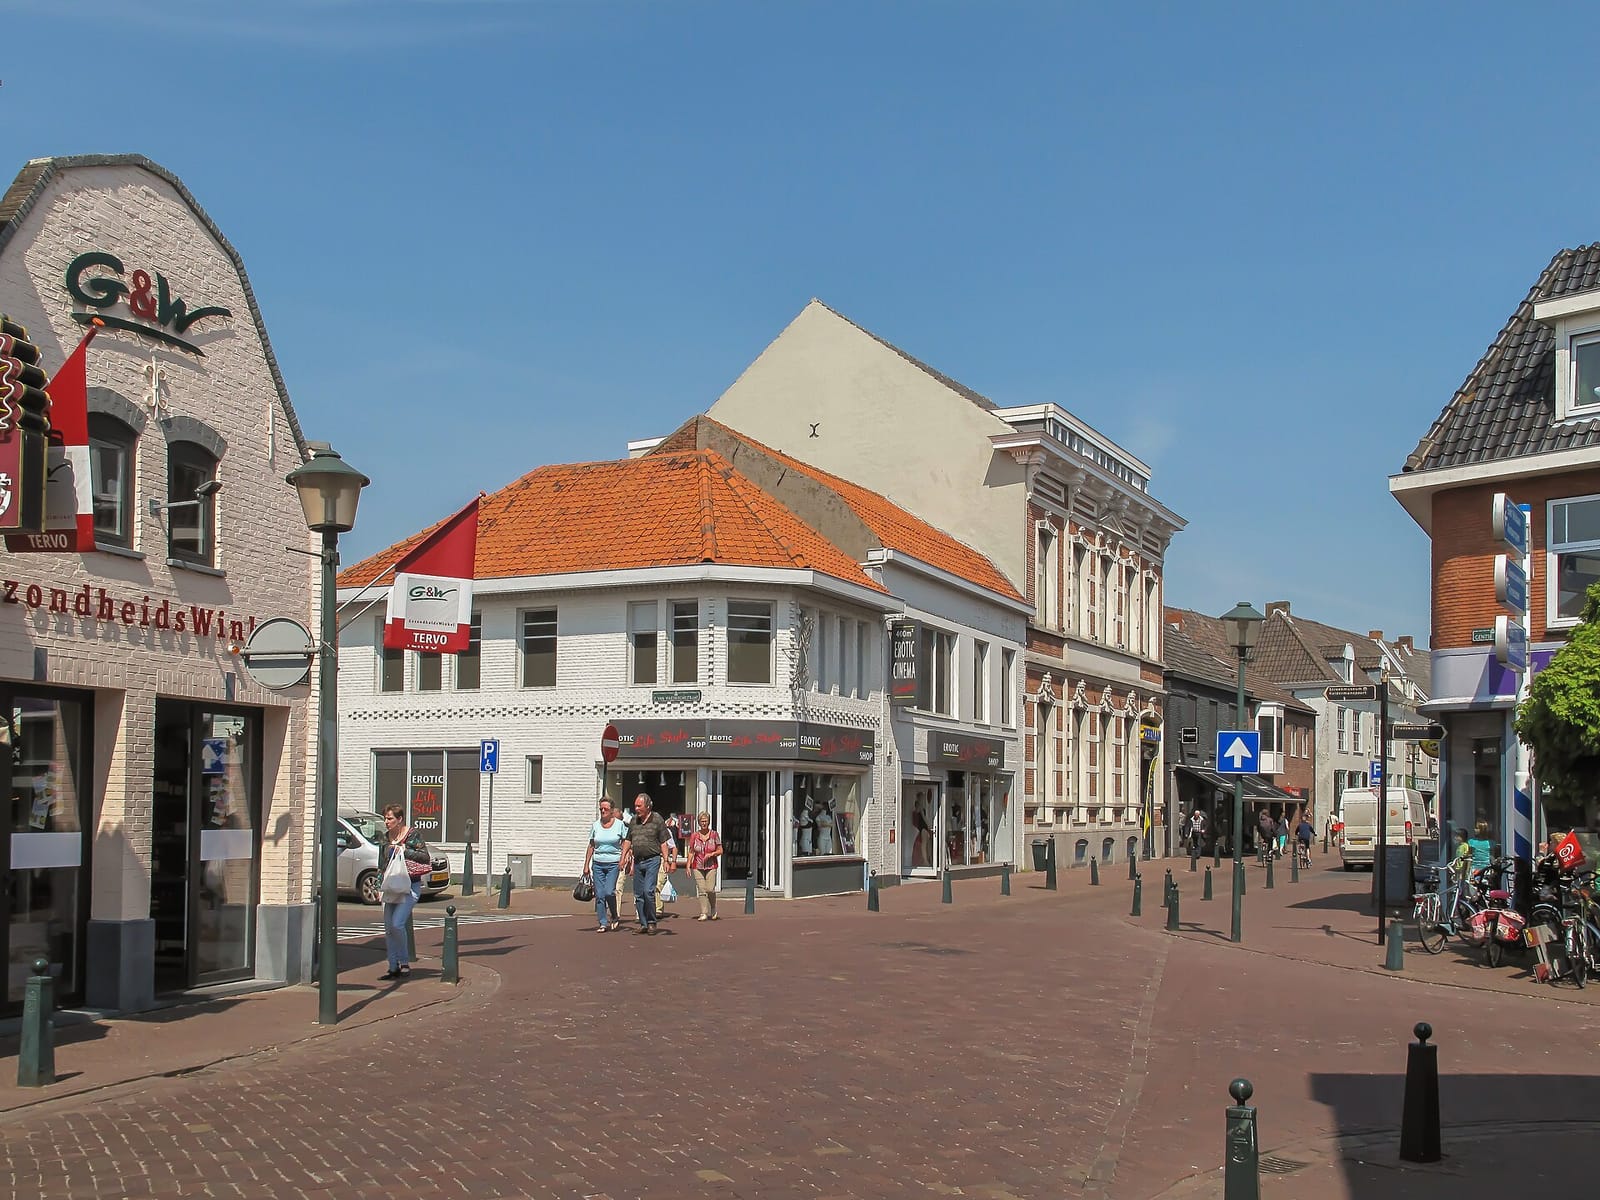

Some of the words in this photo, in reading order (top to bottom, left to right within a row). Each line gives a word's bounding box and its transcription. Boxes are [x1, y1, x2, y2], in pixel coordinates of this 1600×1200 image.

[28, 533, 68, 549] TERVO
[409, 586, 457, 598] G&W
[413, 632, 448, 645] TERVO
[894, 640, 915, 658] EROTIC
[893, 661, 916, 680] CINEMA
[484, 742, 495, 760] P
[800, 735, 821, 747] EROTIC
[859, 751, 874, 761] SHOP
[943, 742, 960, 753] EROTIC
[988, 757, 999, 766] SHOP
[412, 775, 445, 784] EROTIC
[414, 820, 439, 829] SHOP
